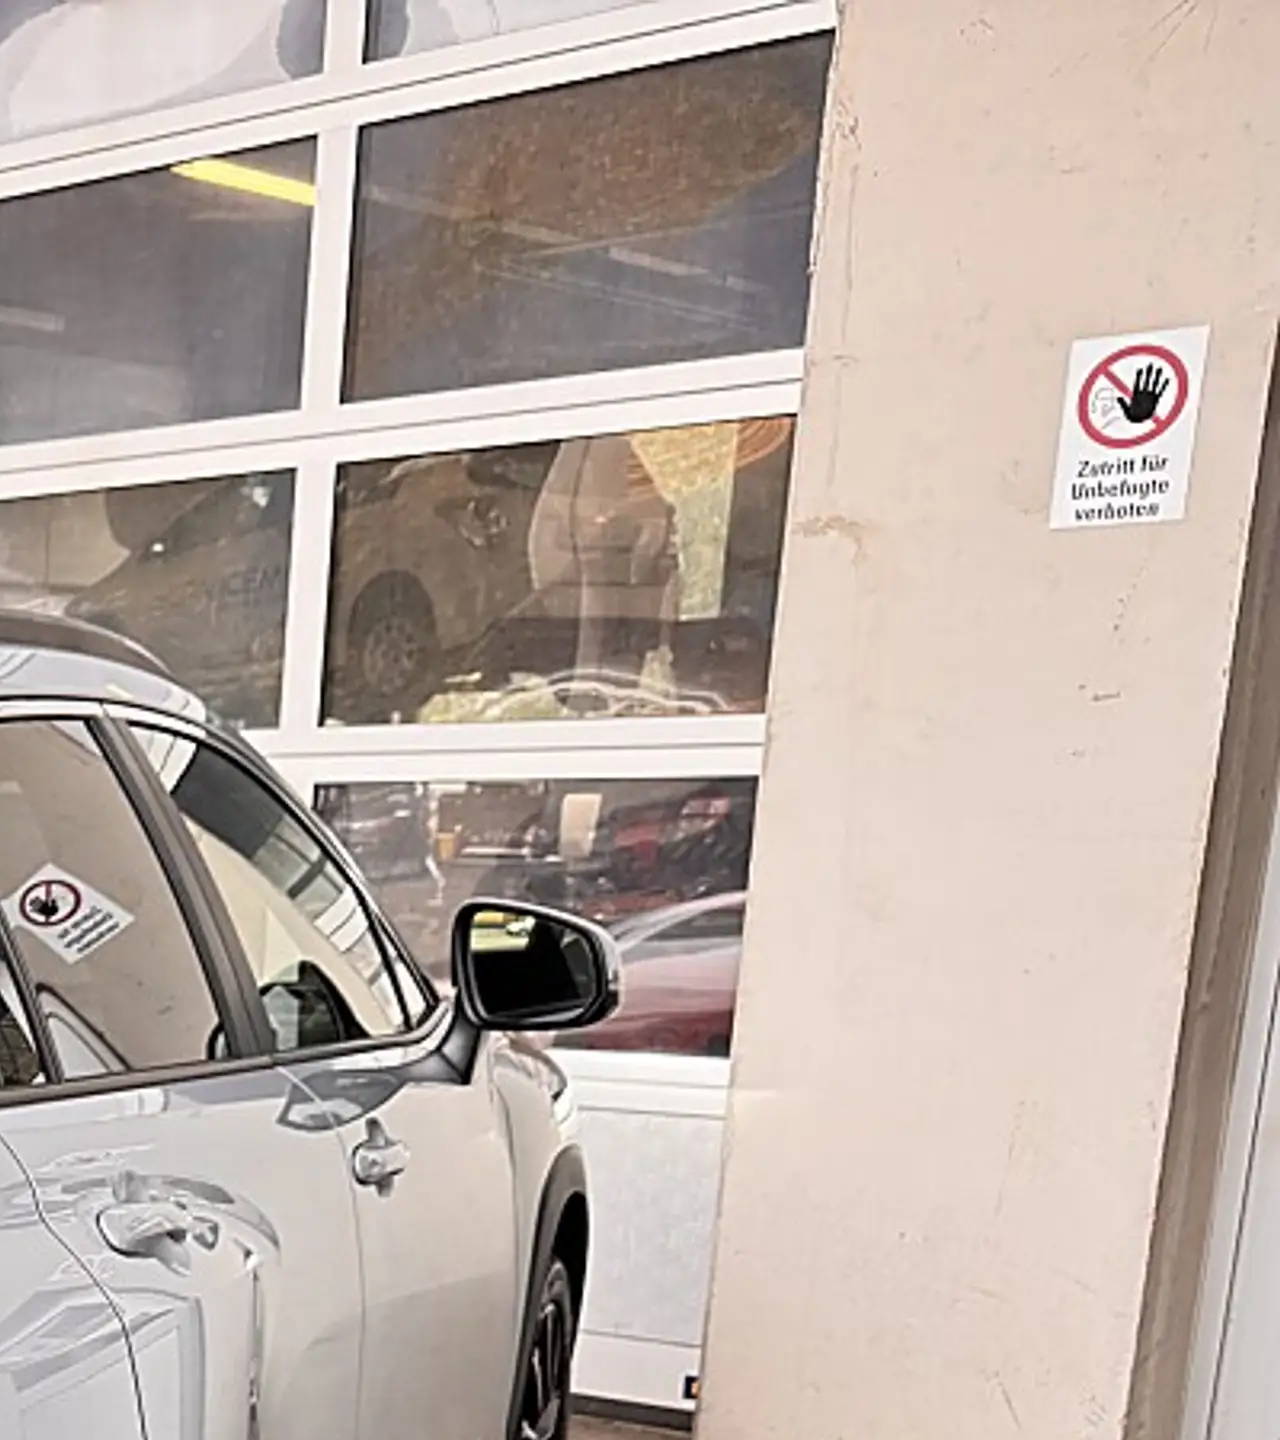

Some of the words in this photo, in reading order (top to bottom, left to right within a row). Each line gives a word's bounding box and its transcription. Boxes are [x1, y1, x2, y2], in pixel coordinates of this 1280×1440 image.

[1077, 456, 1135, 478] Zutritt
[1140, 453, 1169, 473] für
[1071, 477, 1170, 500] Unbefugte
[1074, 502, 1160, 521] verboten
